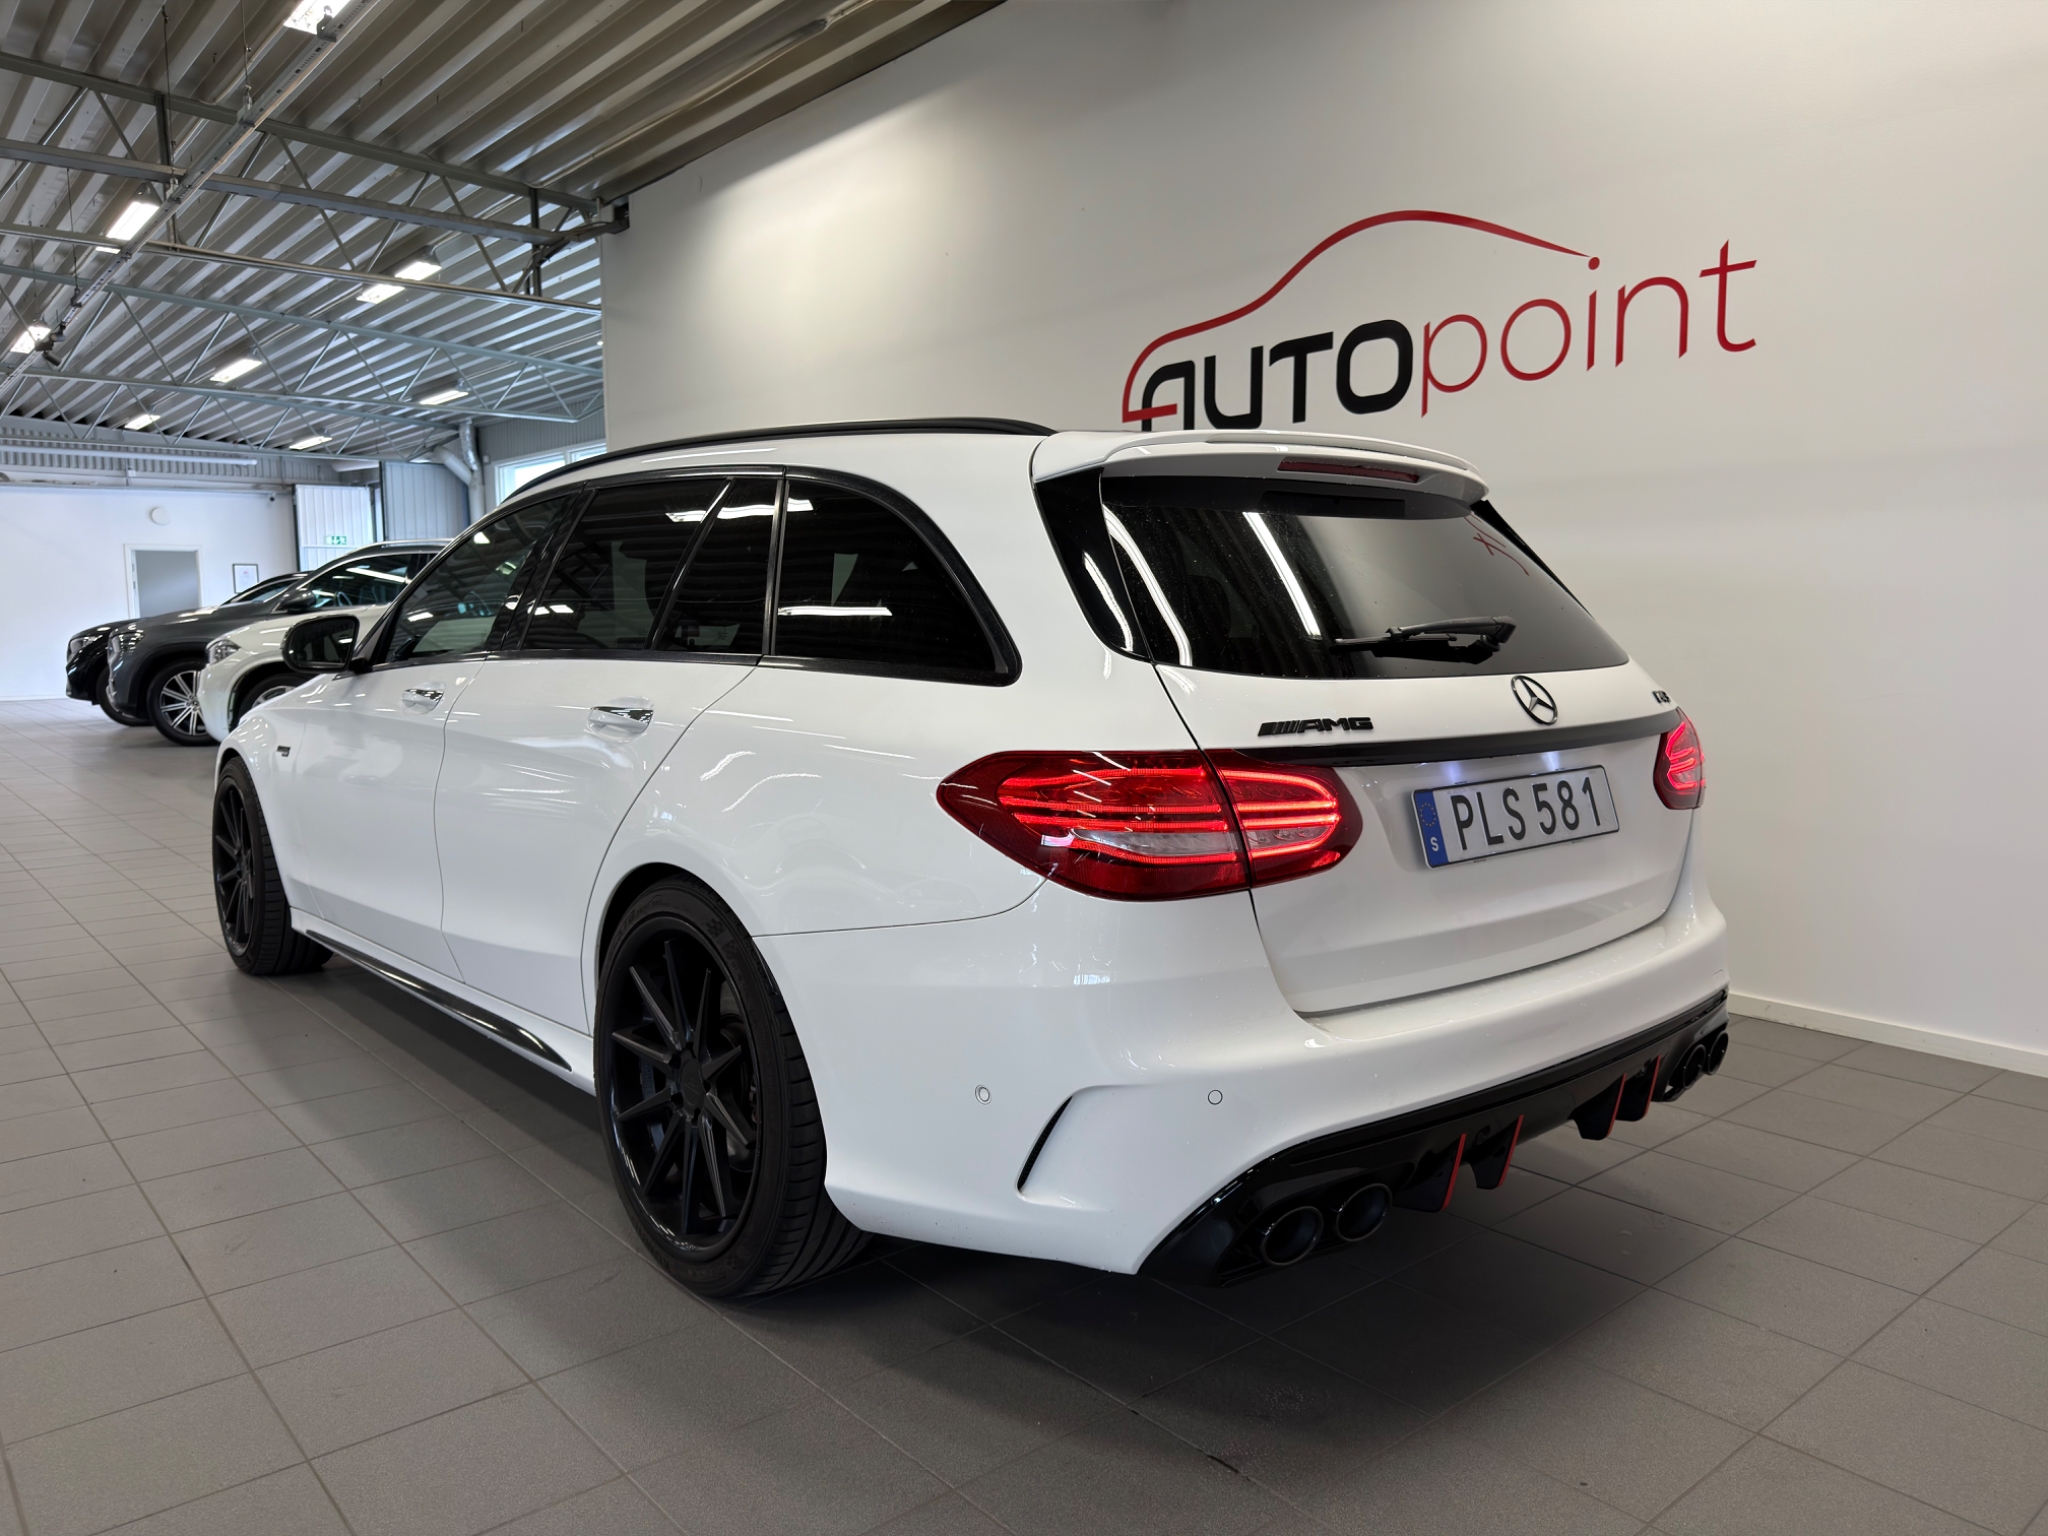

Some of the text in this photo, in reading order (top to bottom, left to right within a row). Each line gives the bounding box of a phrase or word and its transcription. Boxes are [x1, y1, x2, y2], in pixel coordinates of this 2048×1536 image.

[1122, 238, 1758, 431] AUTOpoint
[1297, 717, 1374, 733] AMG
[1450, 776, 1601, 851] PLS 581
[1430, 837, 1439, 852] S
